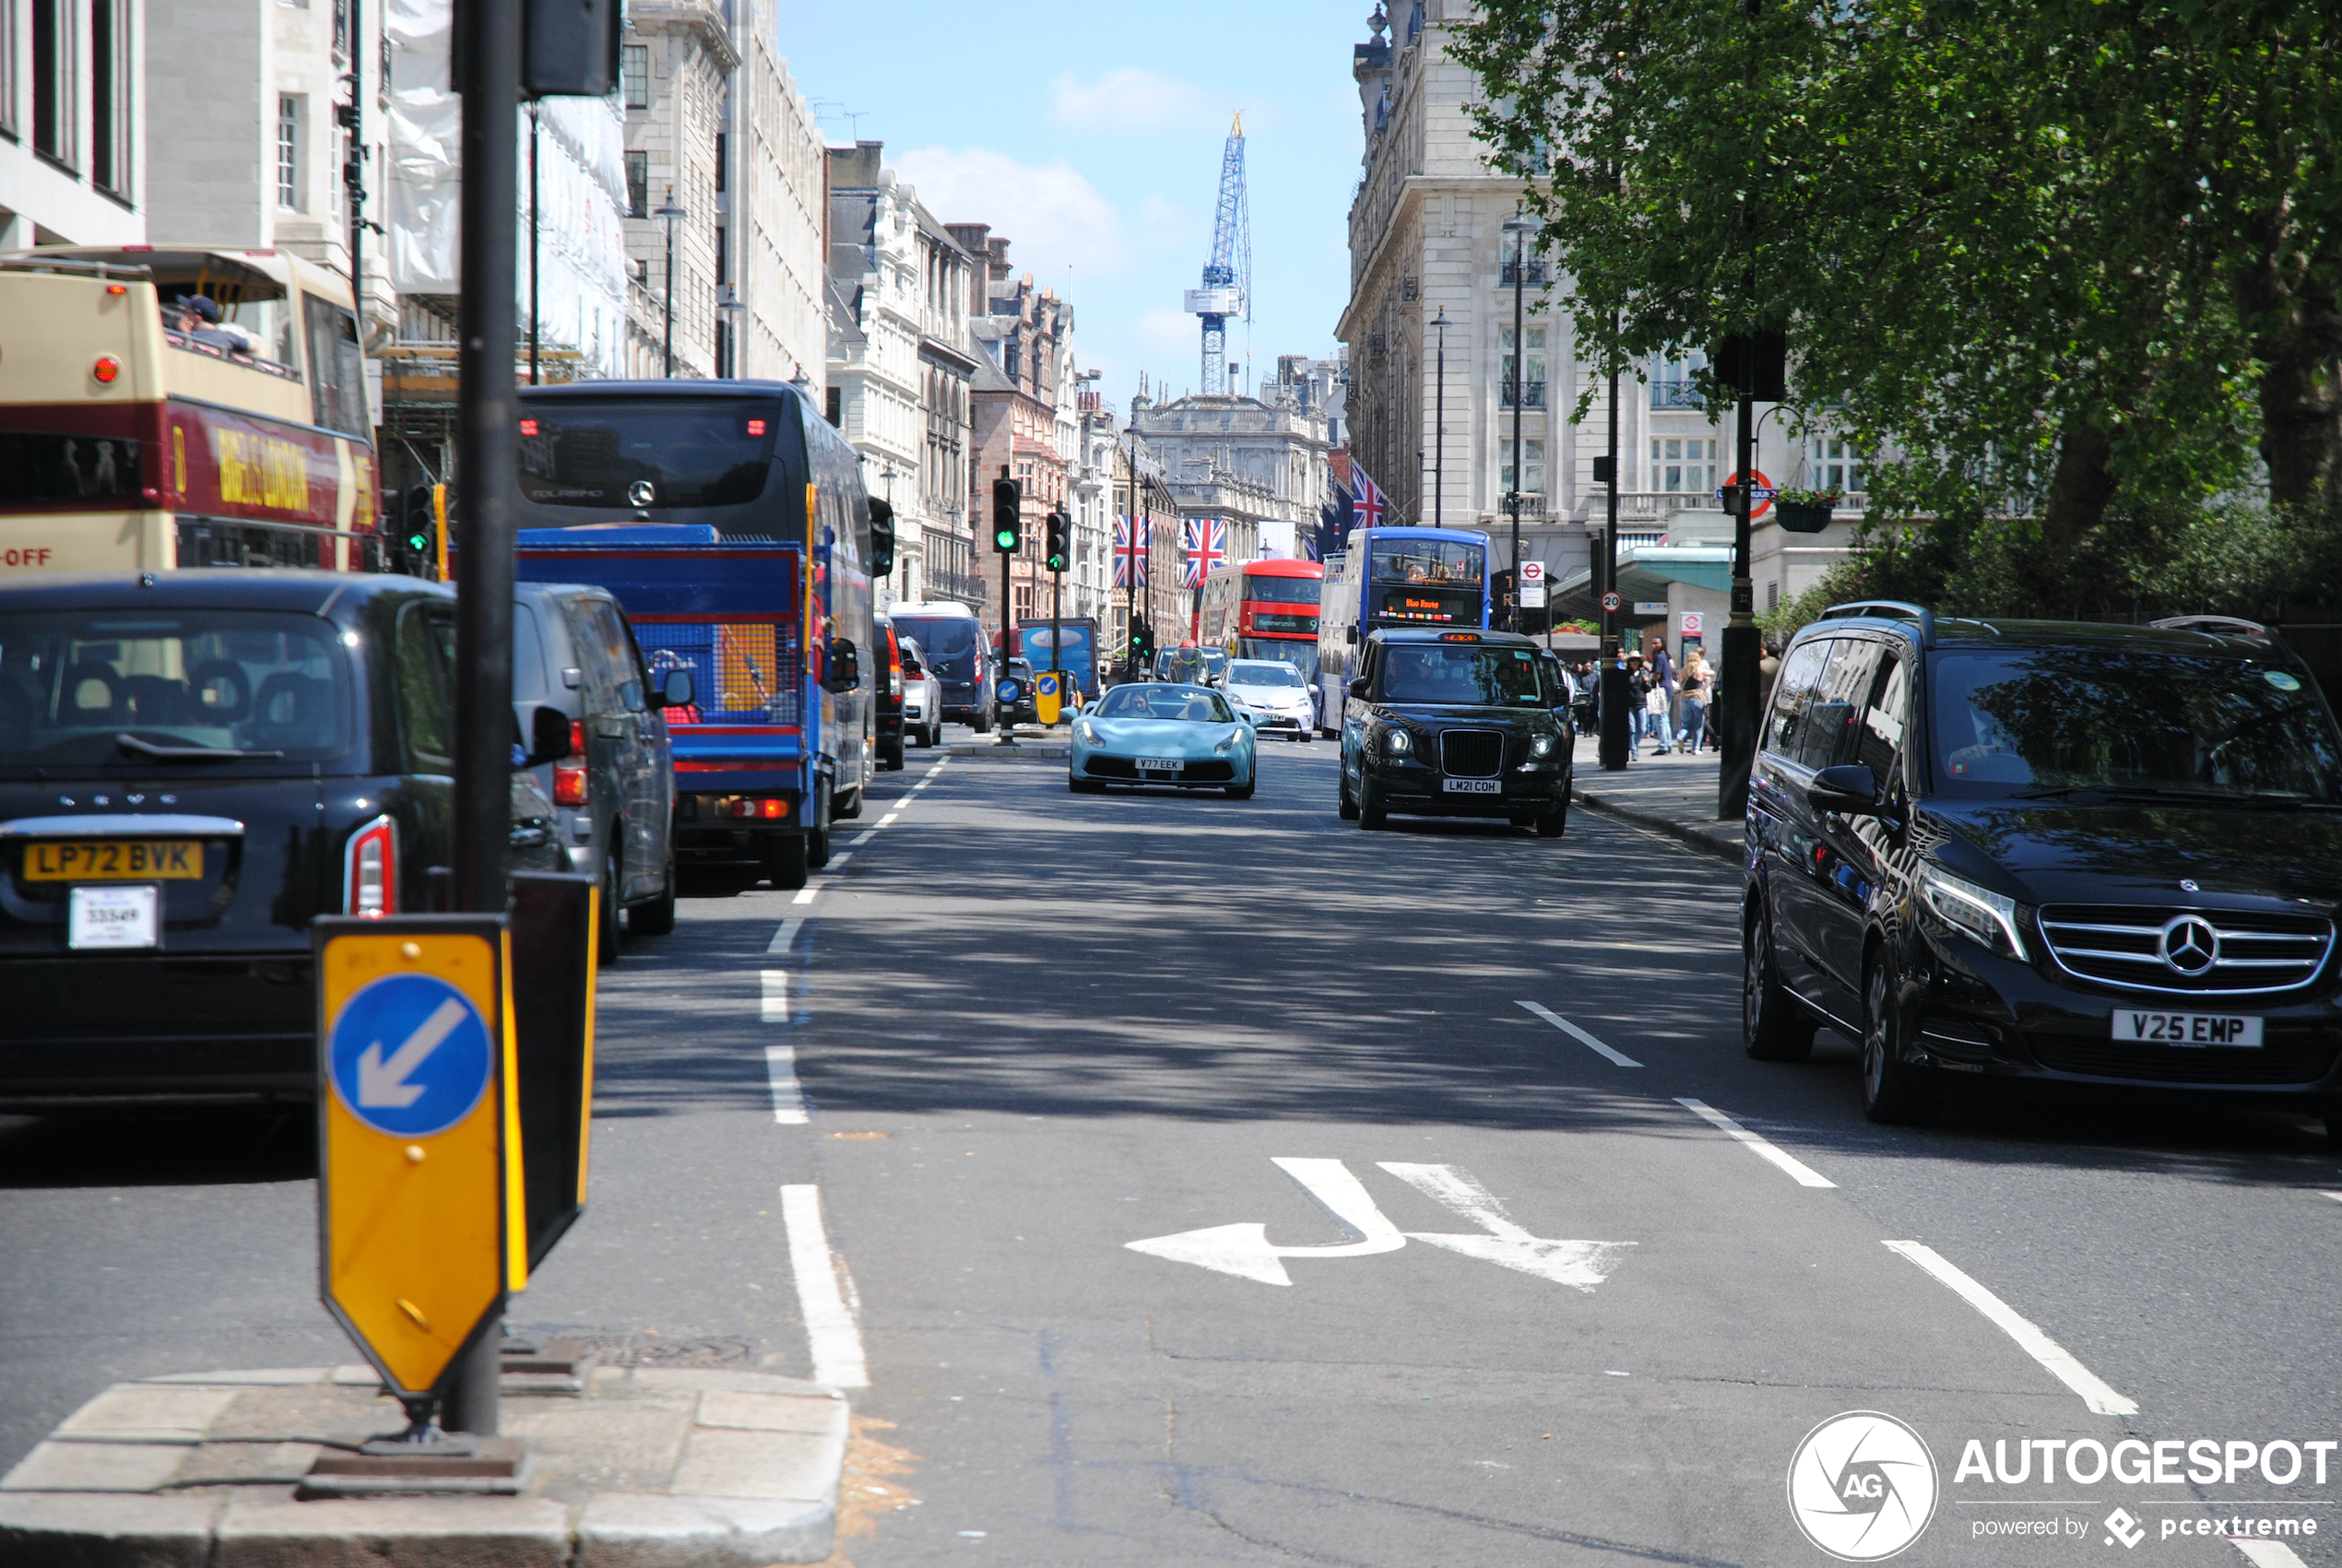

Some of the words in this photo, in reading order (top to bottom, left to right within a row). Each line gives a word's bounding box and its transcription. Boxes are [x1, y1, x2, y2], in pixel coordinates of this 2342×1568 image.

[1604, 597, 1619, 606] 20
[1258, 619, 1296, 628] Hammersmith
[1309, 619, 1318, 631] 9
[1141, 759, 1158, 768] V77
[1160, 760, 1178, 769] EEK
[1449, 780, 1473, 791] LM21
[1474, 781, 1496, 792] COH
[38, 844, 122, 873] LP72
[129, 843, 190, 871] BVK
[2133, 1013, 2185, 1041] V25
[2192, 1017, 2244, 1043] EMP
